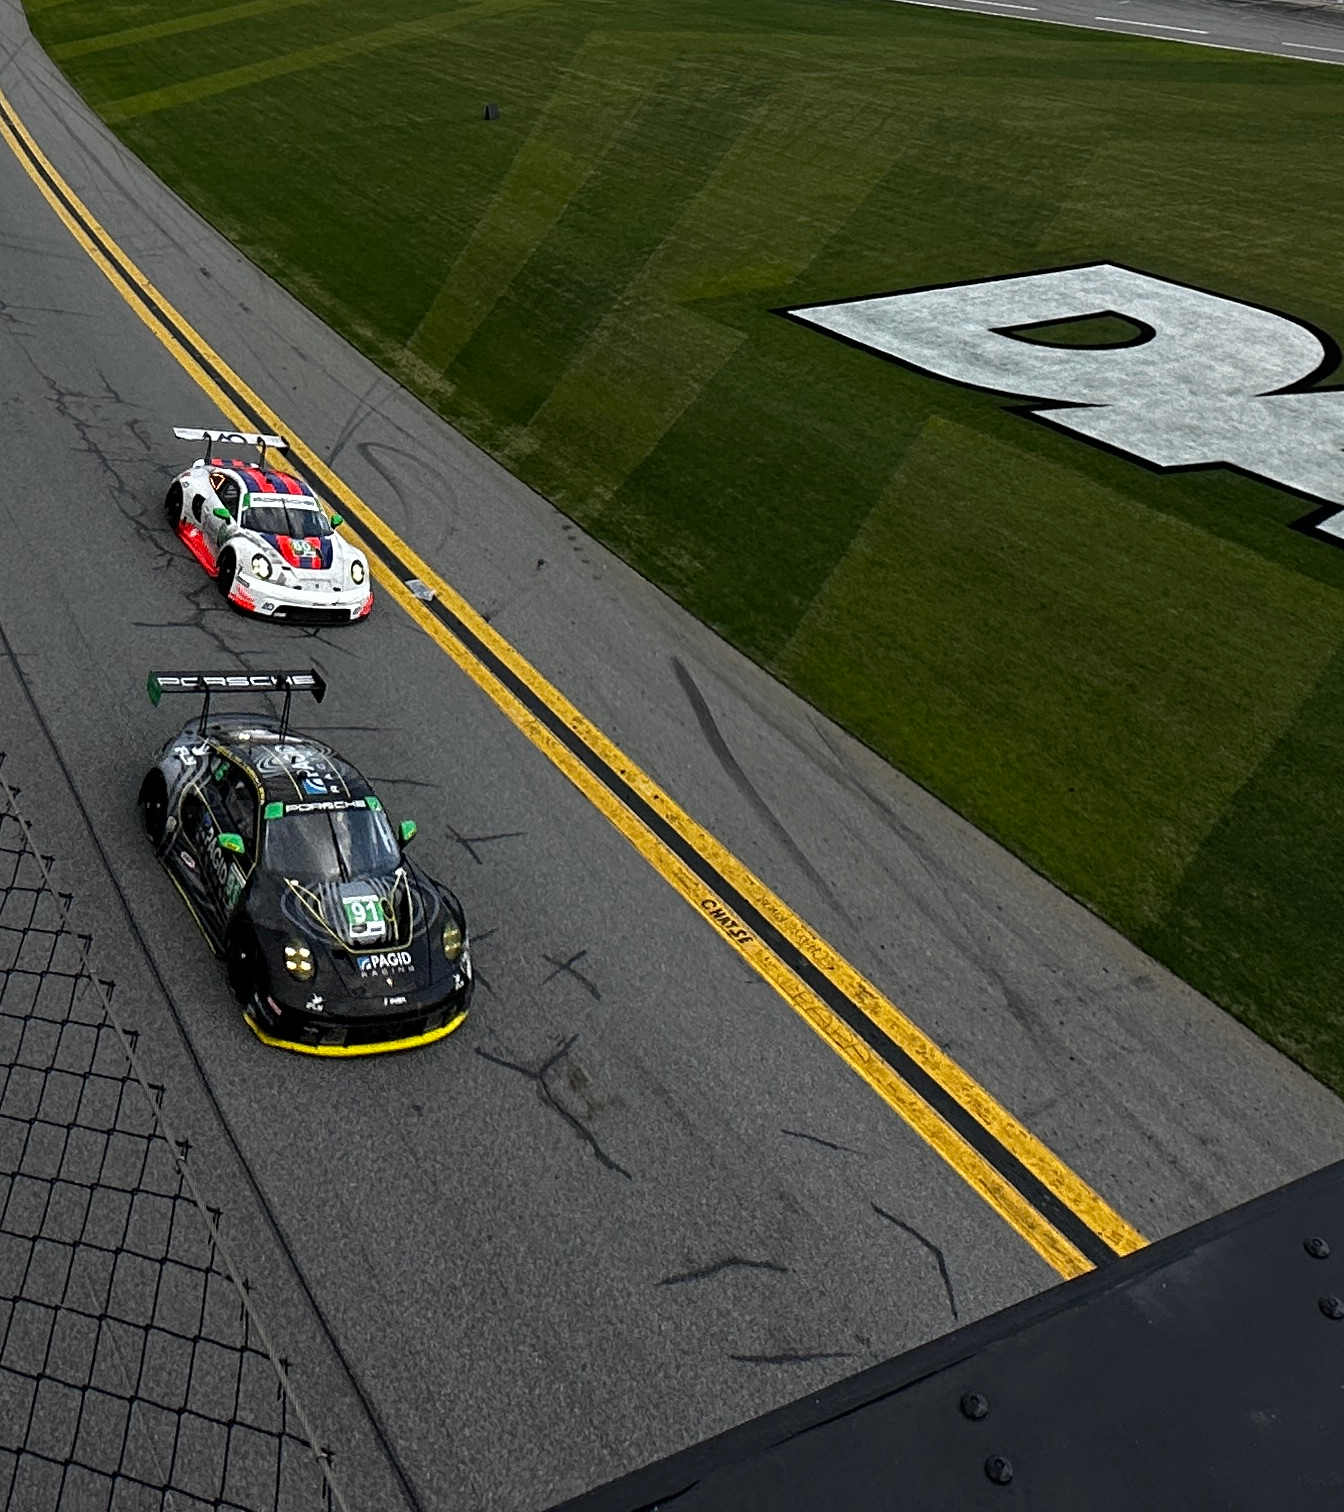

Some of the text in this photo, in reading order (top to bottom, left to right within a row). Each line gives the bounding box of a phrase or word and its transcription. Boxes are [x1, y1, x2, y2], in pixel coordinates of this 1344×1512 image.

[156, 675, 316, 687] PORSCHE
[285, 800, 367, 813] PORSCHE
[351, 901, 381, 924] 91
[370, 951, 413, 969] PAGID
[360, 964, 416, 979] RACING
